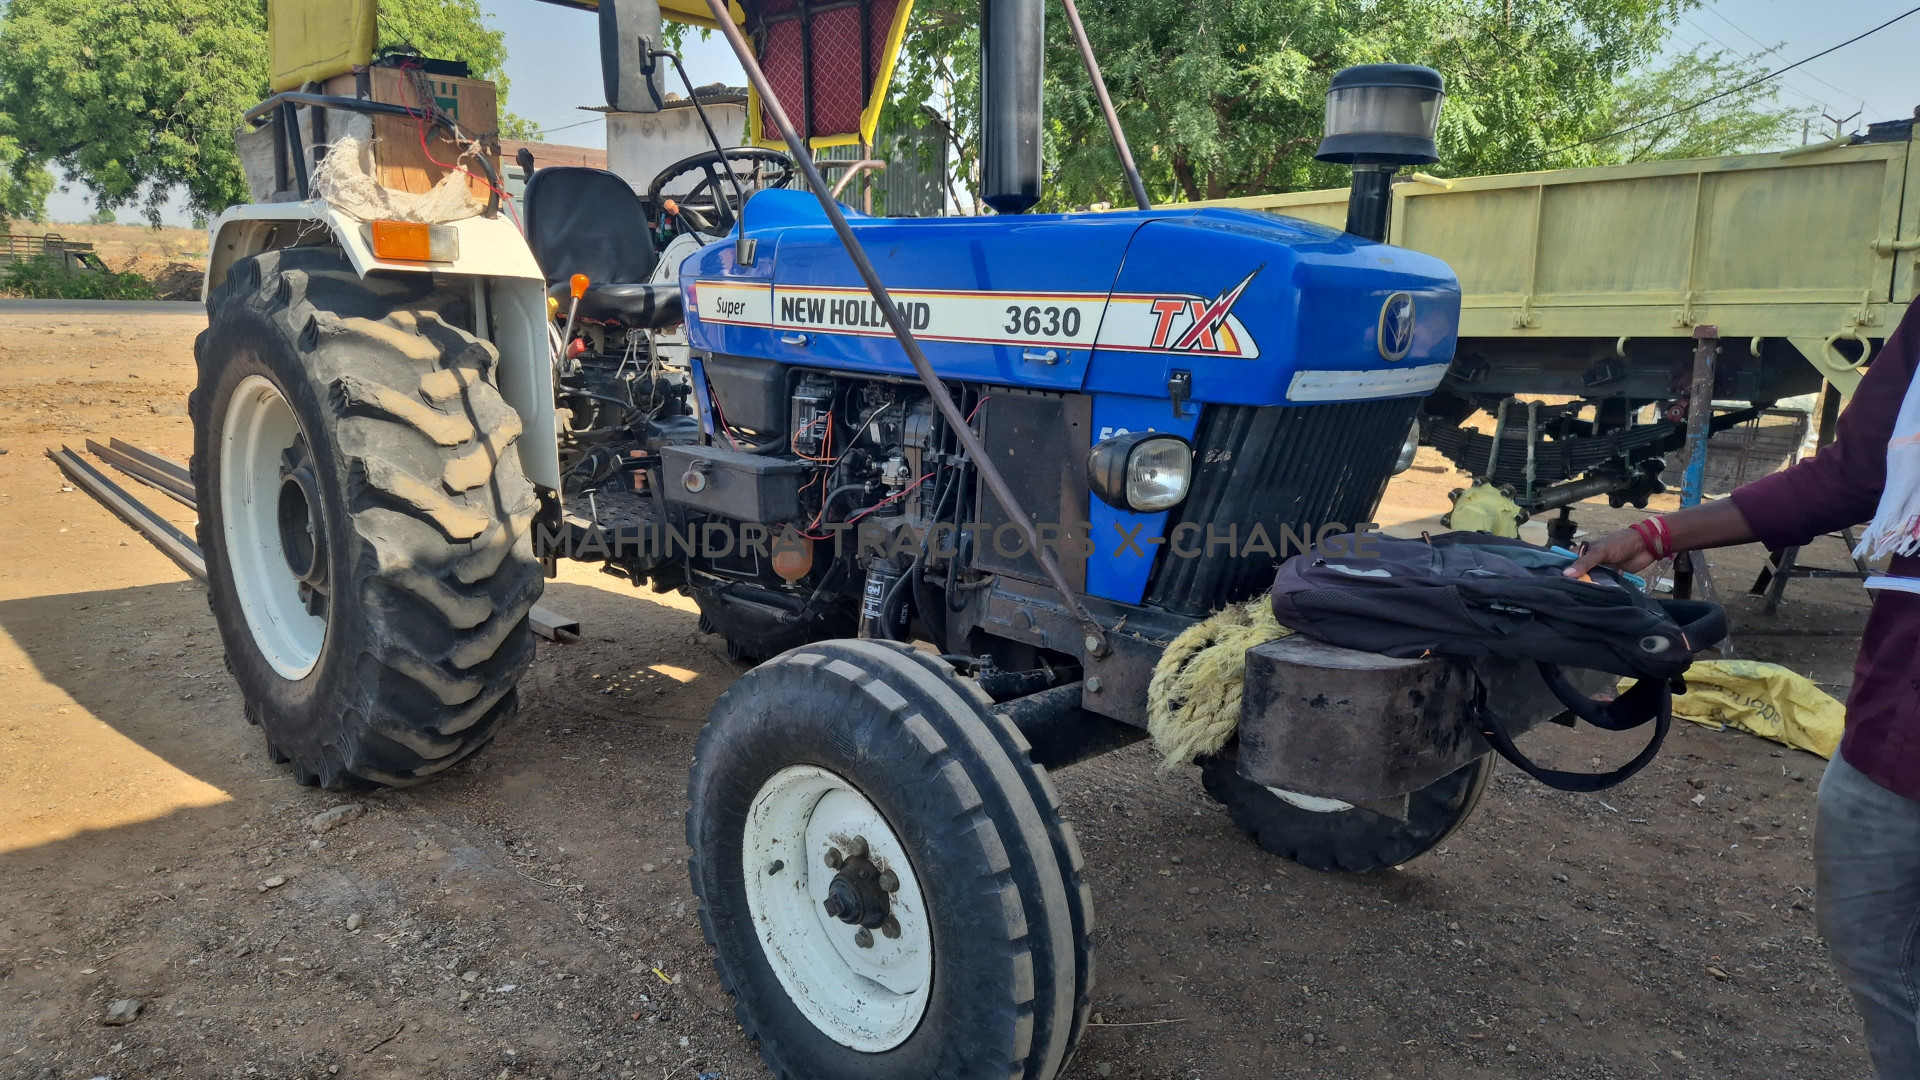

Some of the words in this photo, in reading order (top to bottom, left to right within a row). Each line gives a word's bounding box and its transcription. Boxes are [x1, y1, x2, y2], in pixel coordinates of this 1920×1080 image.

[716, 296, 746, 318] Super
[781, 296, 826, 324] NEW
[1004, 305, 1081, 337] 3630
